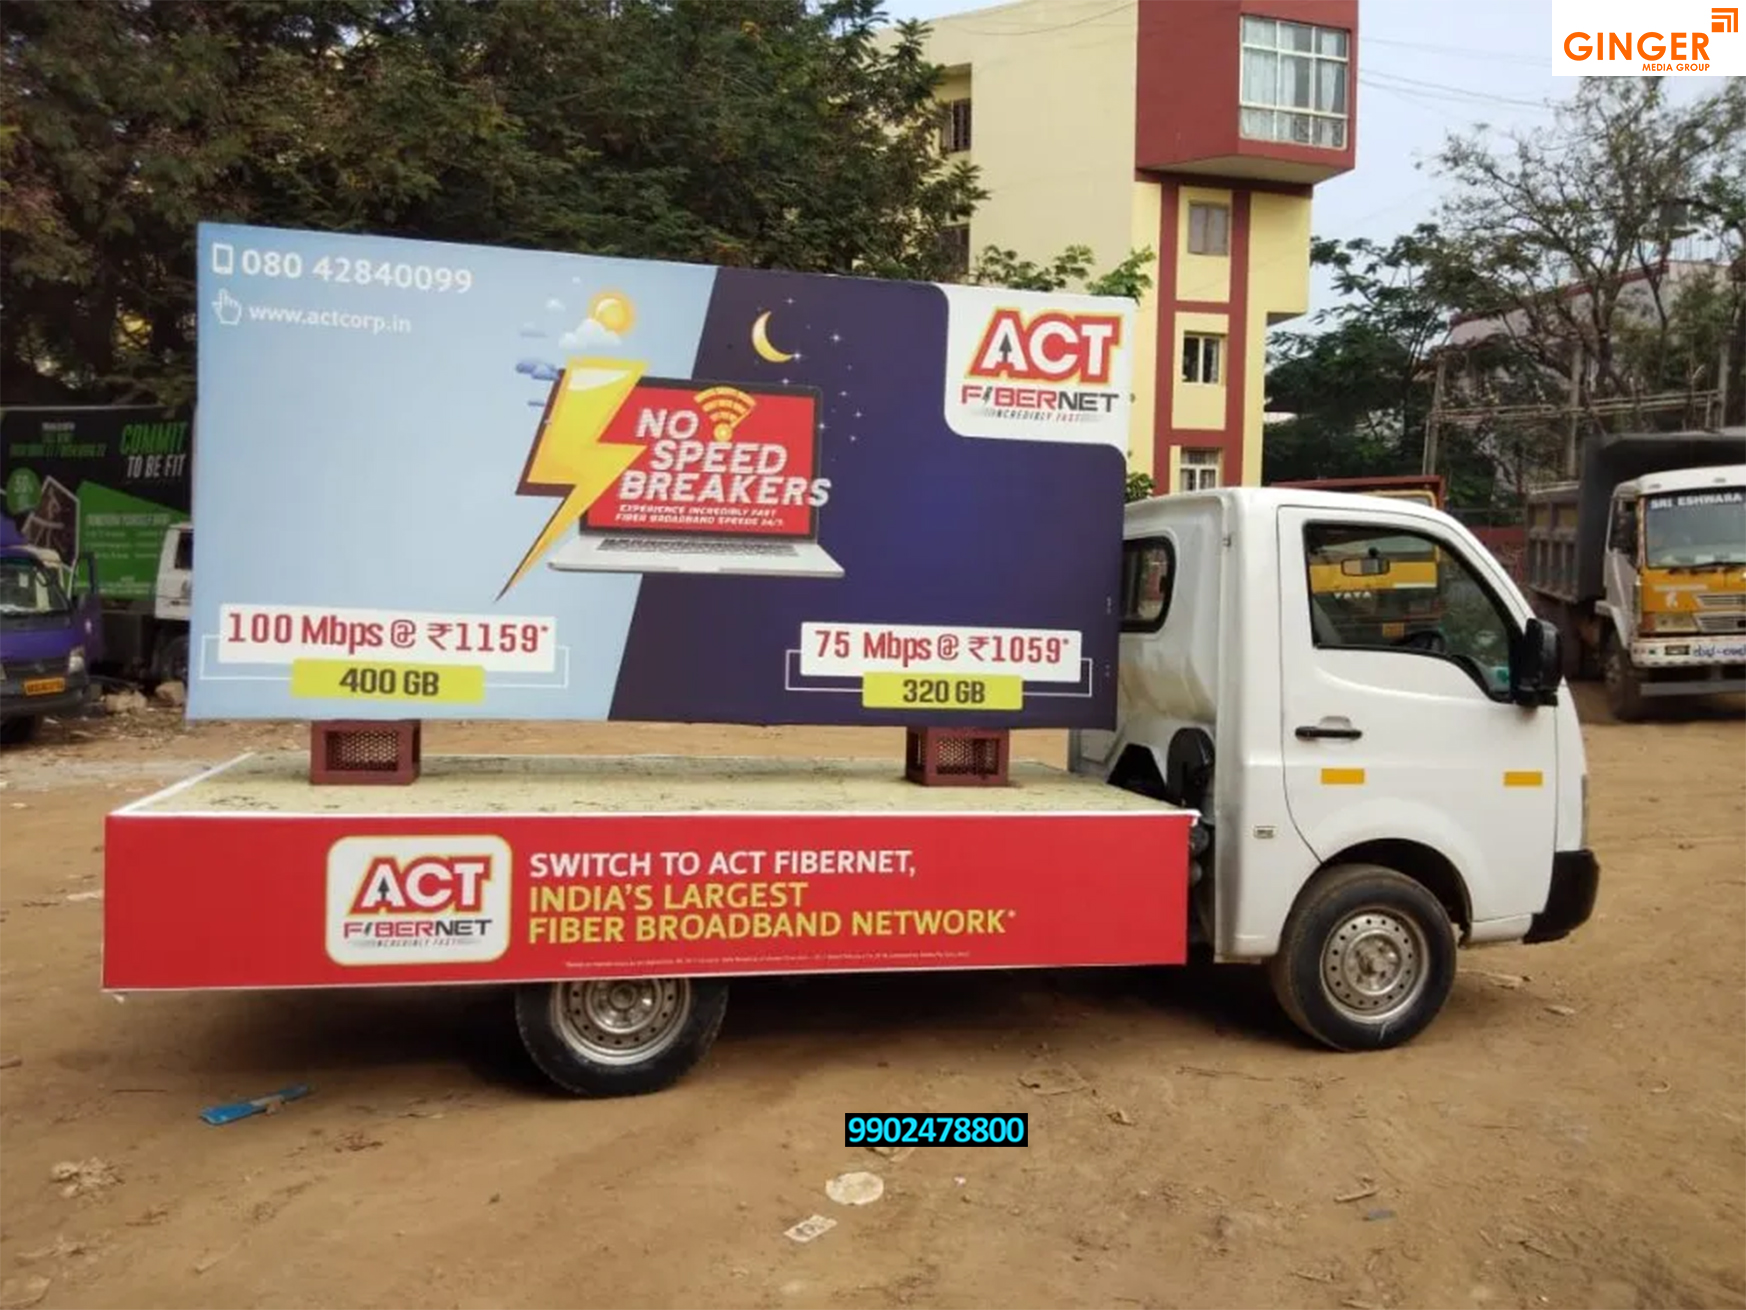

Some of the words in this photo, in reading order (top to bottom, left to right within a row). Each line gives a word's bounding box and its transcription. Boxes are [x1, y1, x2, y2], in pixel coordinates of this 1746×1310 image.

[241, 249, 302, 278] 080
[312, 256, 473, 293] 42840099
[249, 304, 412, 335] www.actcorp.in
[980, 318, 1114, 376] ACT
[120, 423, 187, 454] COMMIT
[635, 408, 699, 440] NO
[126, 456, 143, 478] TO
[145, 456, 161, 478] BE
[164, 455, 186, 477] FIT
[650, 439, 788, 474] SPEED
[618, 470, 832, 507] BREAKERS
[1650, 498, 1672, 509] SRI
[615, 513, 648, 522] FIBER
[649, 514, 714, 525] BROADBAND
[718, 516, 758, 526] SPEEDS
[619, 504, 685, 515] EXPERIENCE
[688, 507, 748, 516] INCREDIBLY
[751, 509, 777, 517] FAST
[228, 612, 292, 643] 100
[302, 614, 383, 654] Mbps
[814, 630, 850, 658] 75
[339, 668, 397, 694] 400
[403, 671, 440, 696] GB
[902, 679, 949, 703] 320
[955, 681, 986, 703] GB
[529, 852, 651, 878] SWITCH
[661, 850, 700, 876] TO
[708, 851, 767, 875] ACT
[775, 850, 916, 877] FIBERNET,
[361, 863, 485, 907] ACT
[529, 884, 653, 913] INDIA’S
[664, 881, 809, 909] LARGEST
[528, 916, 625, 944] FIBER
[635, 911, 842, 942] BROADBAND
